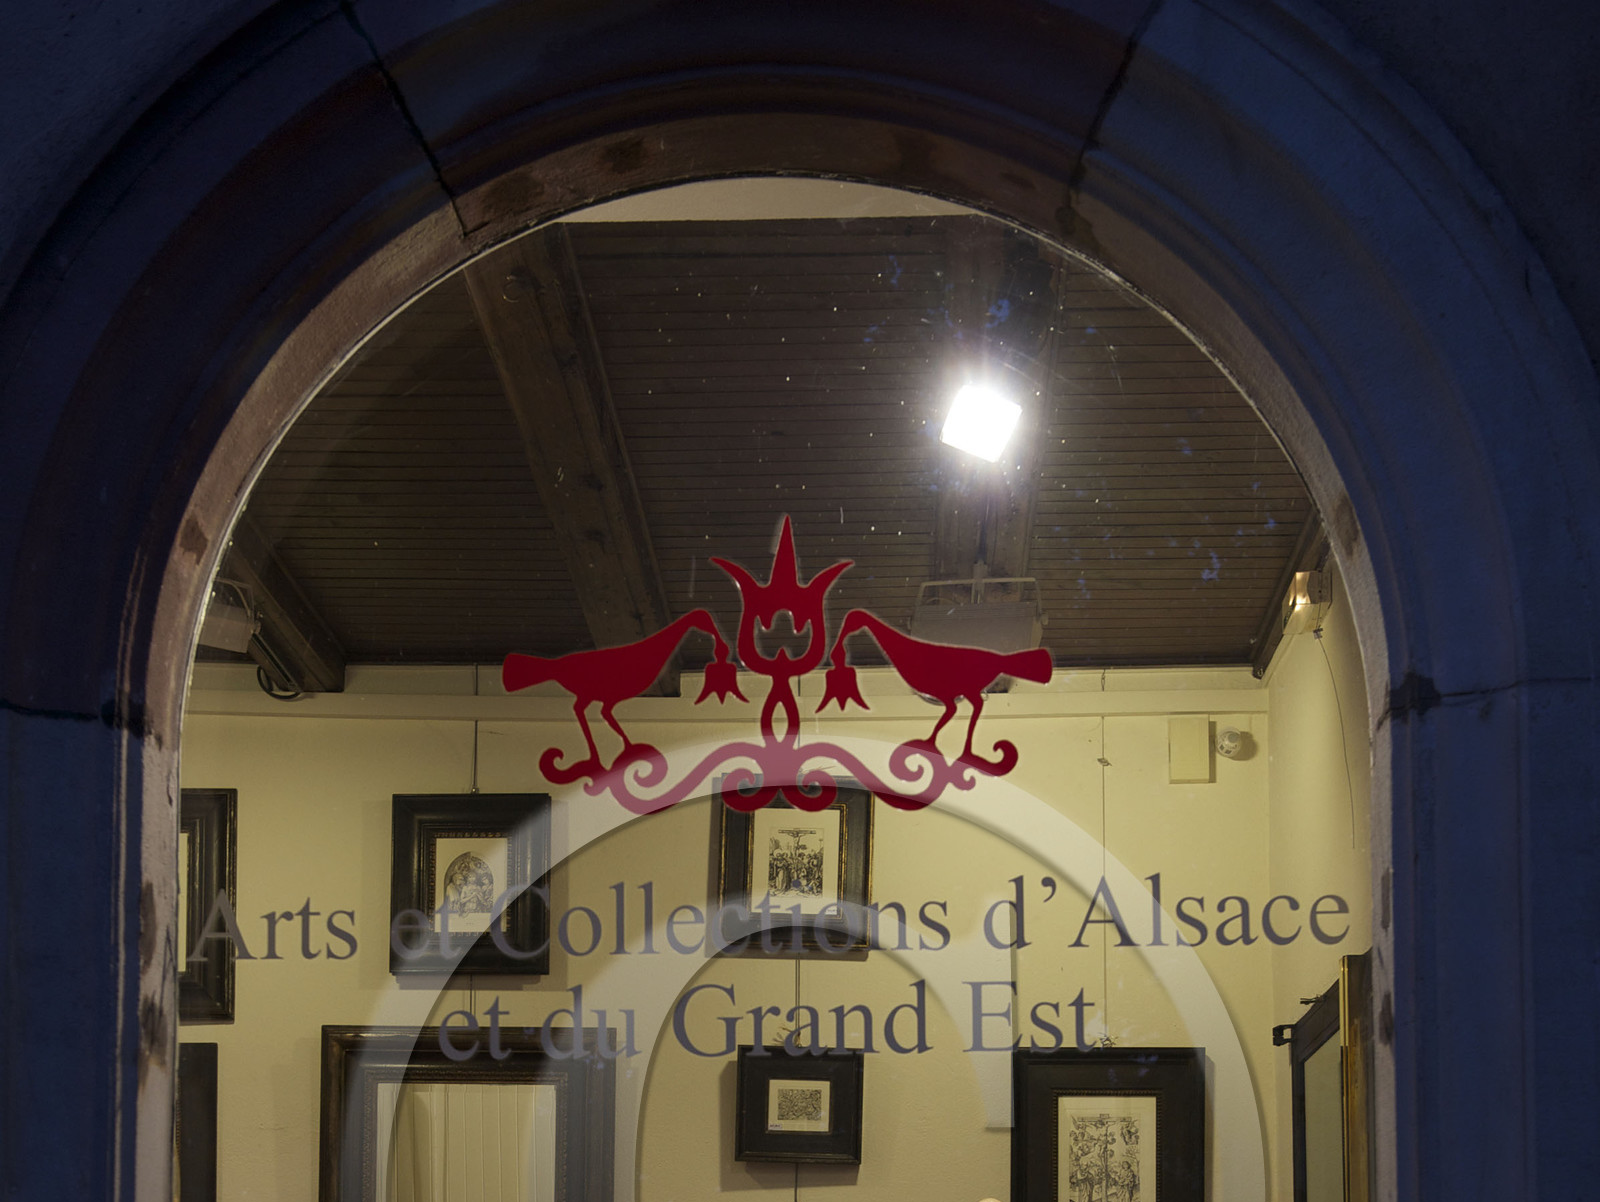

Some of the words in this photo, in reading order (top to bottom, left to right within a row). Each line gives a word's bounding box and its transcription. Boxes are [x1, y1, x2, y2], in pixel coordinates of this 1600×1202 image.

[187, 889, 358, 962] Arts
[390, 895, 461, 961] et
[489, 880, 952, 960] Collections
[437, 996, 512, 1063] et
[540, 985, 642, 1061] du
[672, 979, 933, 1058] Grand
[963, 979, 1099, 1054] Est
